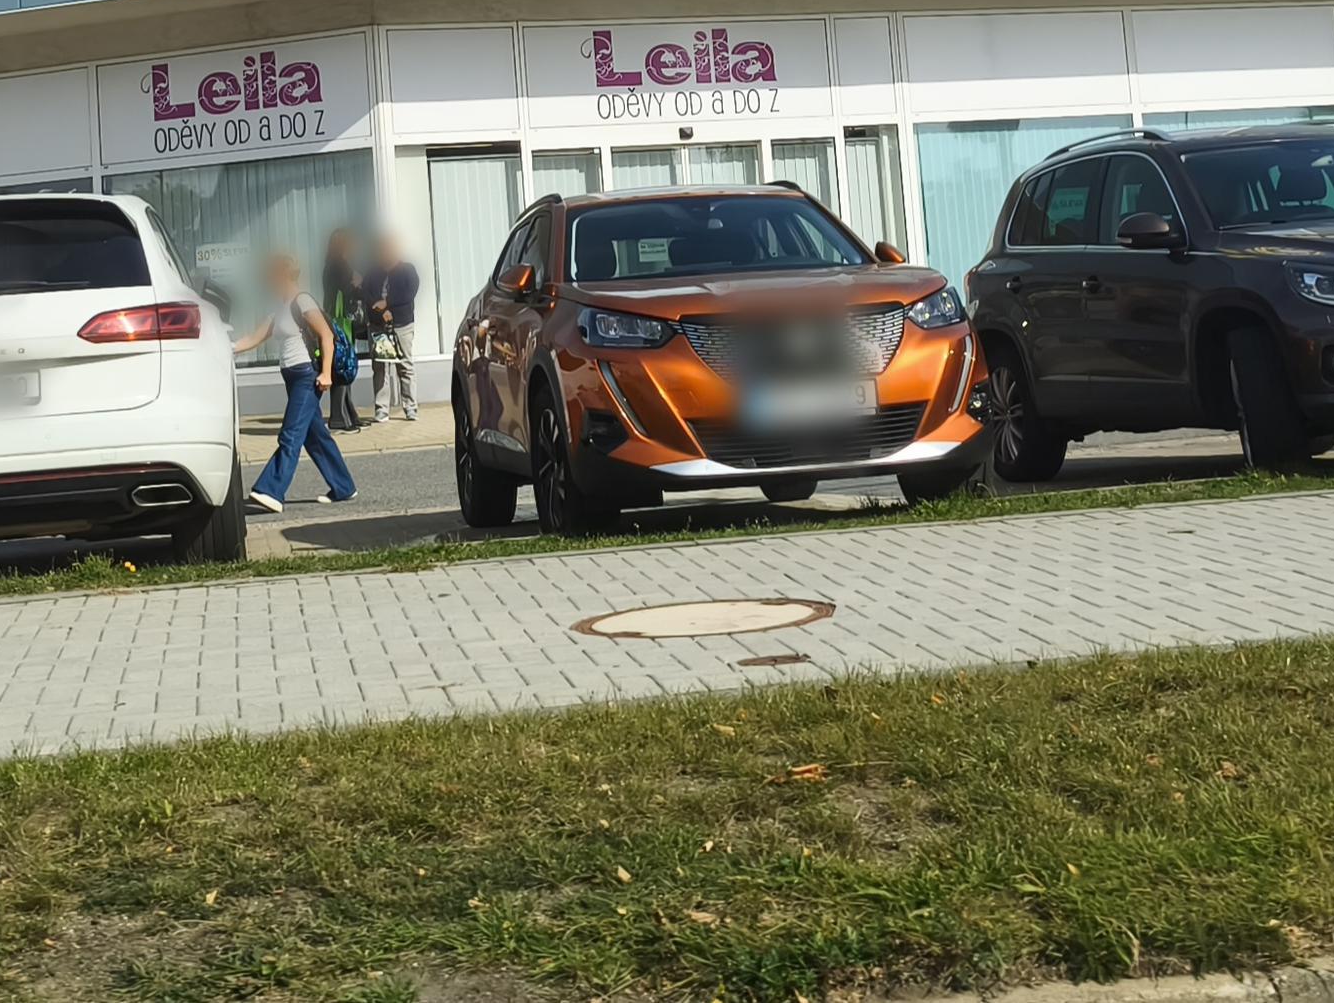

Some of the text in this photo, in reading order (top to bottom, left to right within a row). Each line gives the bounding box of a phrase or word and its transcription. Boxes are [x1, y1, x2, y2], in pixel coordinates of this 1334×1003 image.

[580, 28, 777, 87] Leila
[141, 51, 323, 121] Leila
[675, 91, 702, 116] OD
[733, 89, 761, 114] DO
[769, 88, 780, 113] Z
[224, 119, 251, 146] OD
[279, 112, 307, 139] DO
[313, 110, 325, 135] Z
